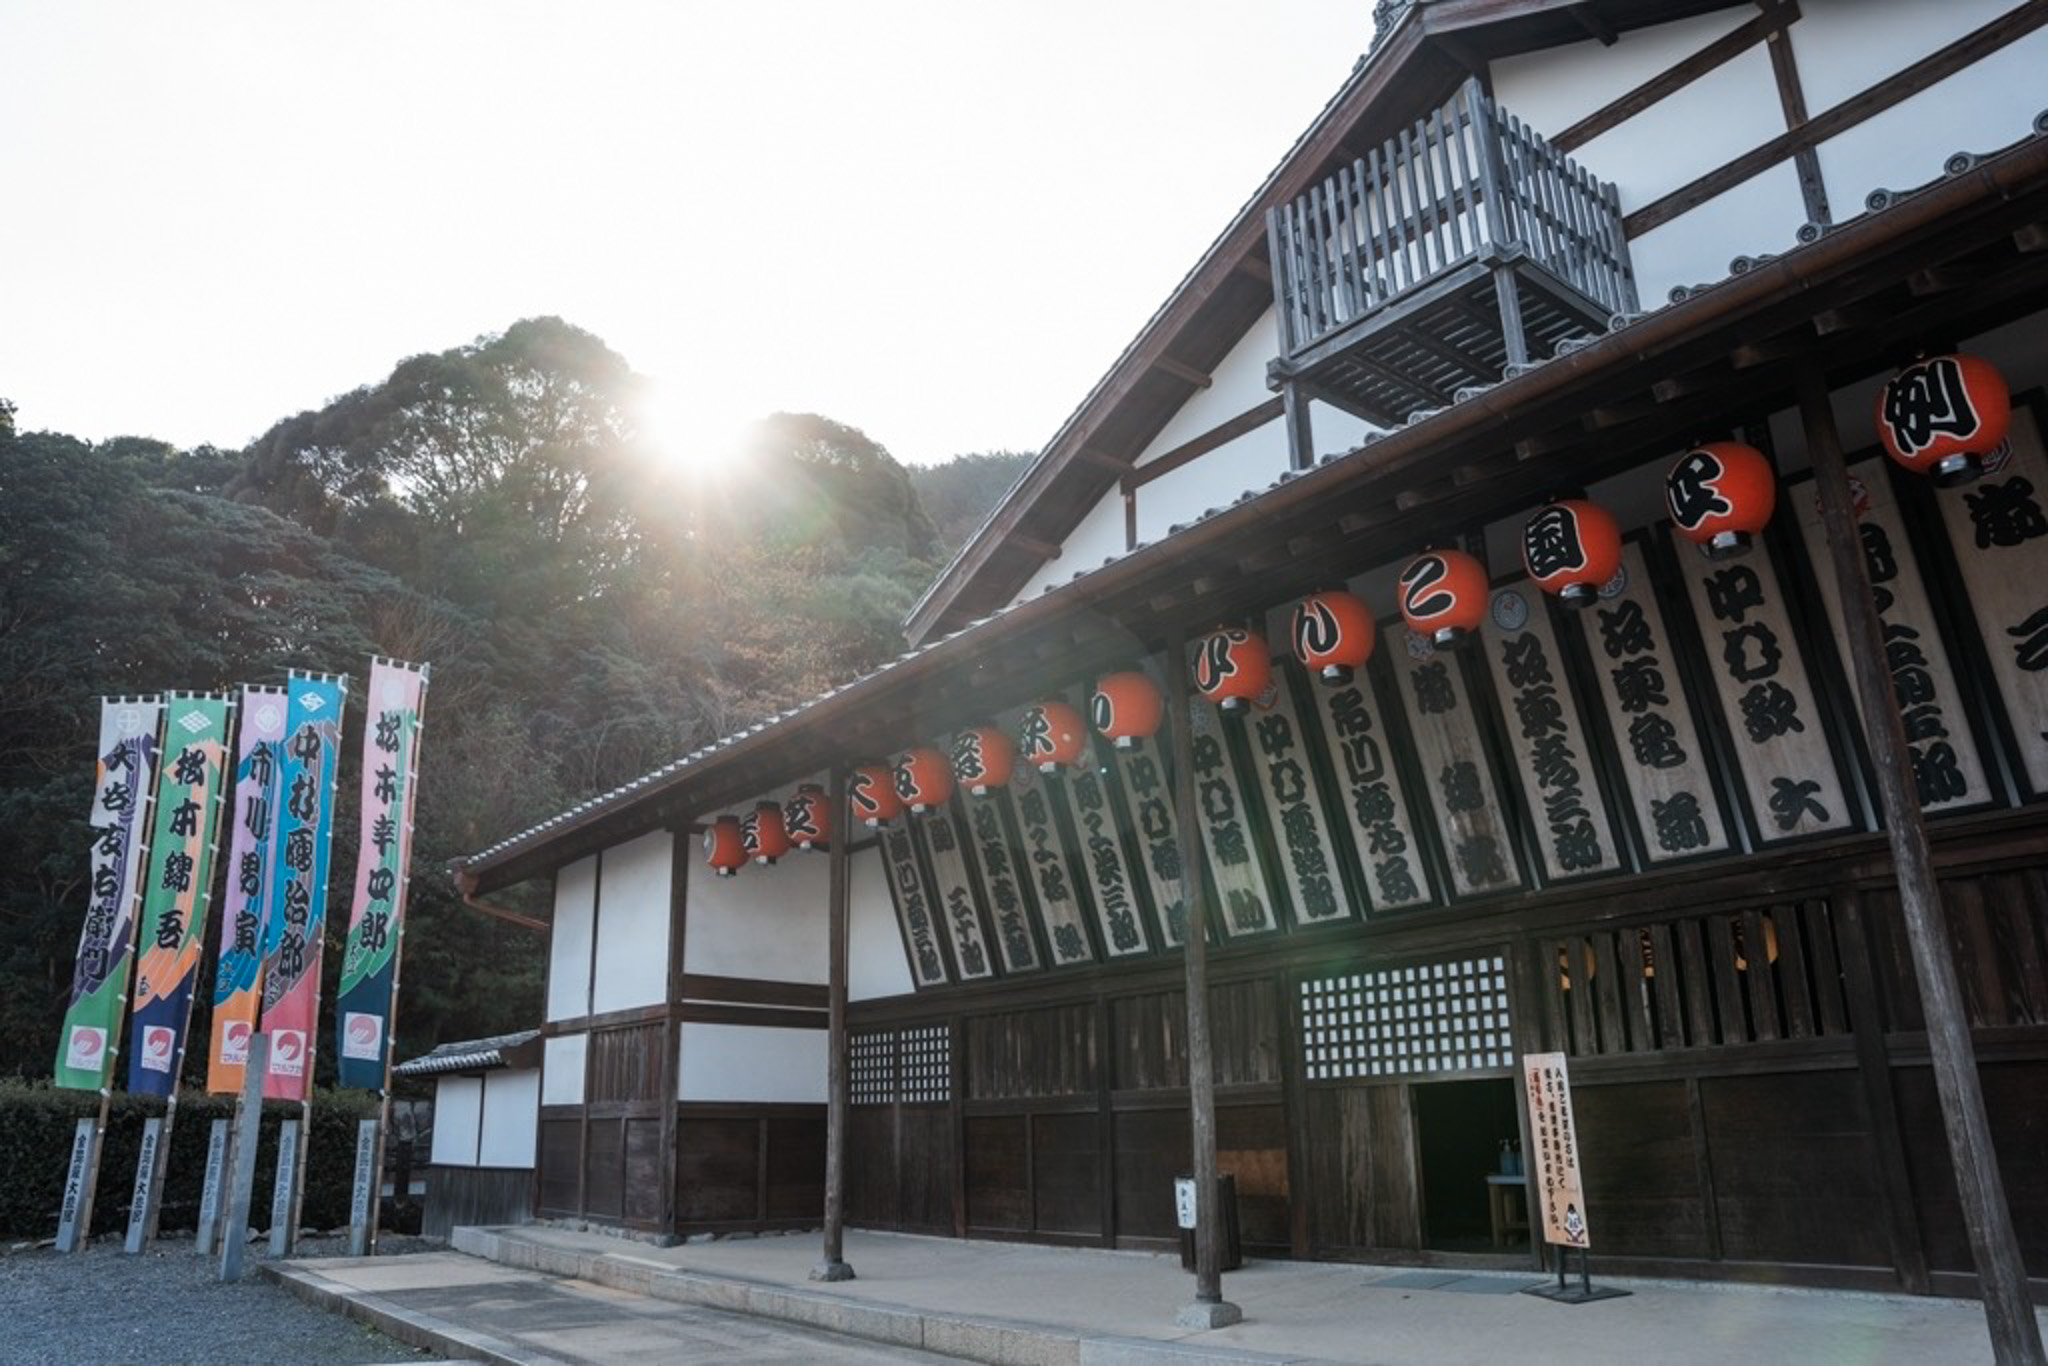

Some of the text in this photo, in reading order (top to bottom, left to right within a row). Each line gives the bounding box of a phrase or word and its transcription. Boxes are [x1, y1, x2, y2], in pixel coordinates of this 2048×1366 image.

[80, 742, 137, 981] 大谷友右衛門
[156, 748, 208, 949] 松本錦吾
[235, 740, 273, 957] 市川男寅
[359, 711, 402, 952] 松本幸四郎
